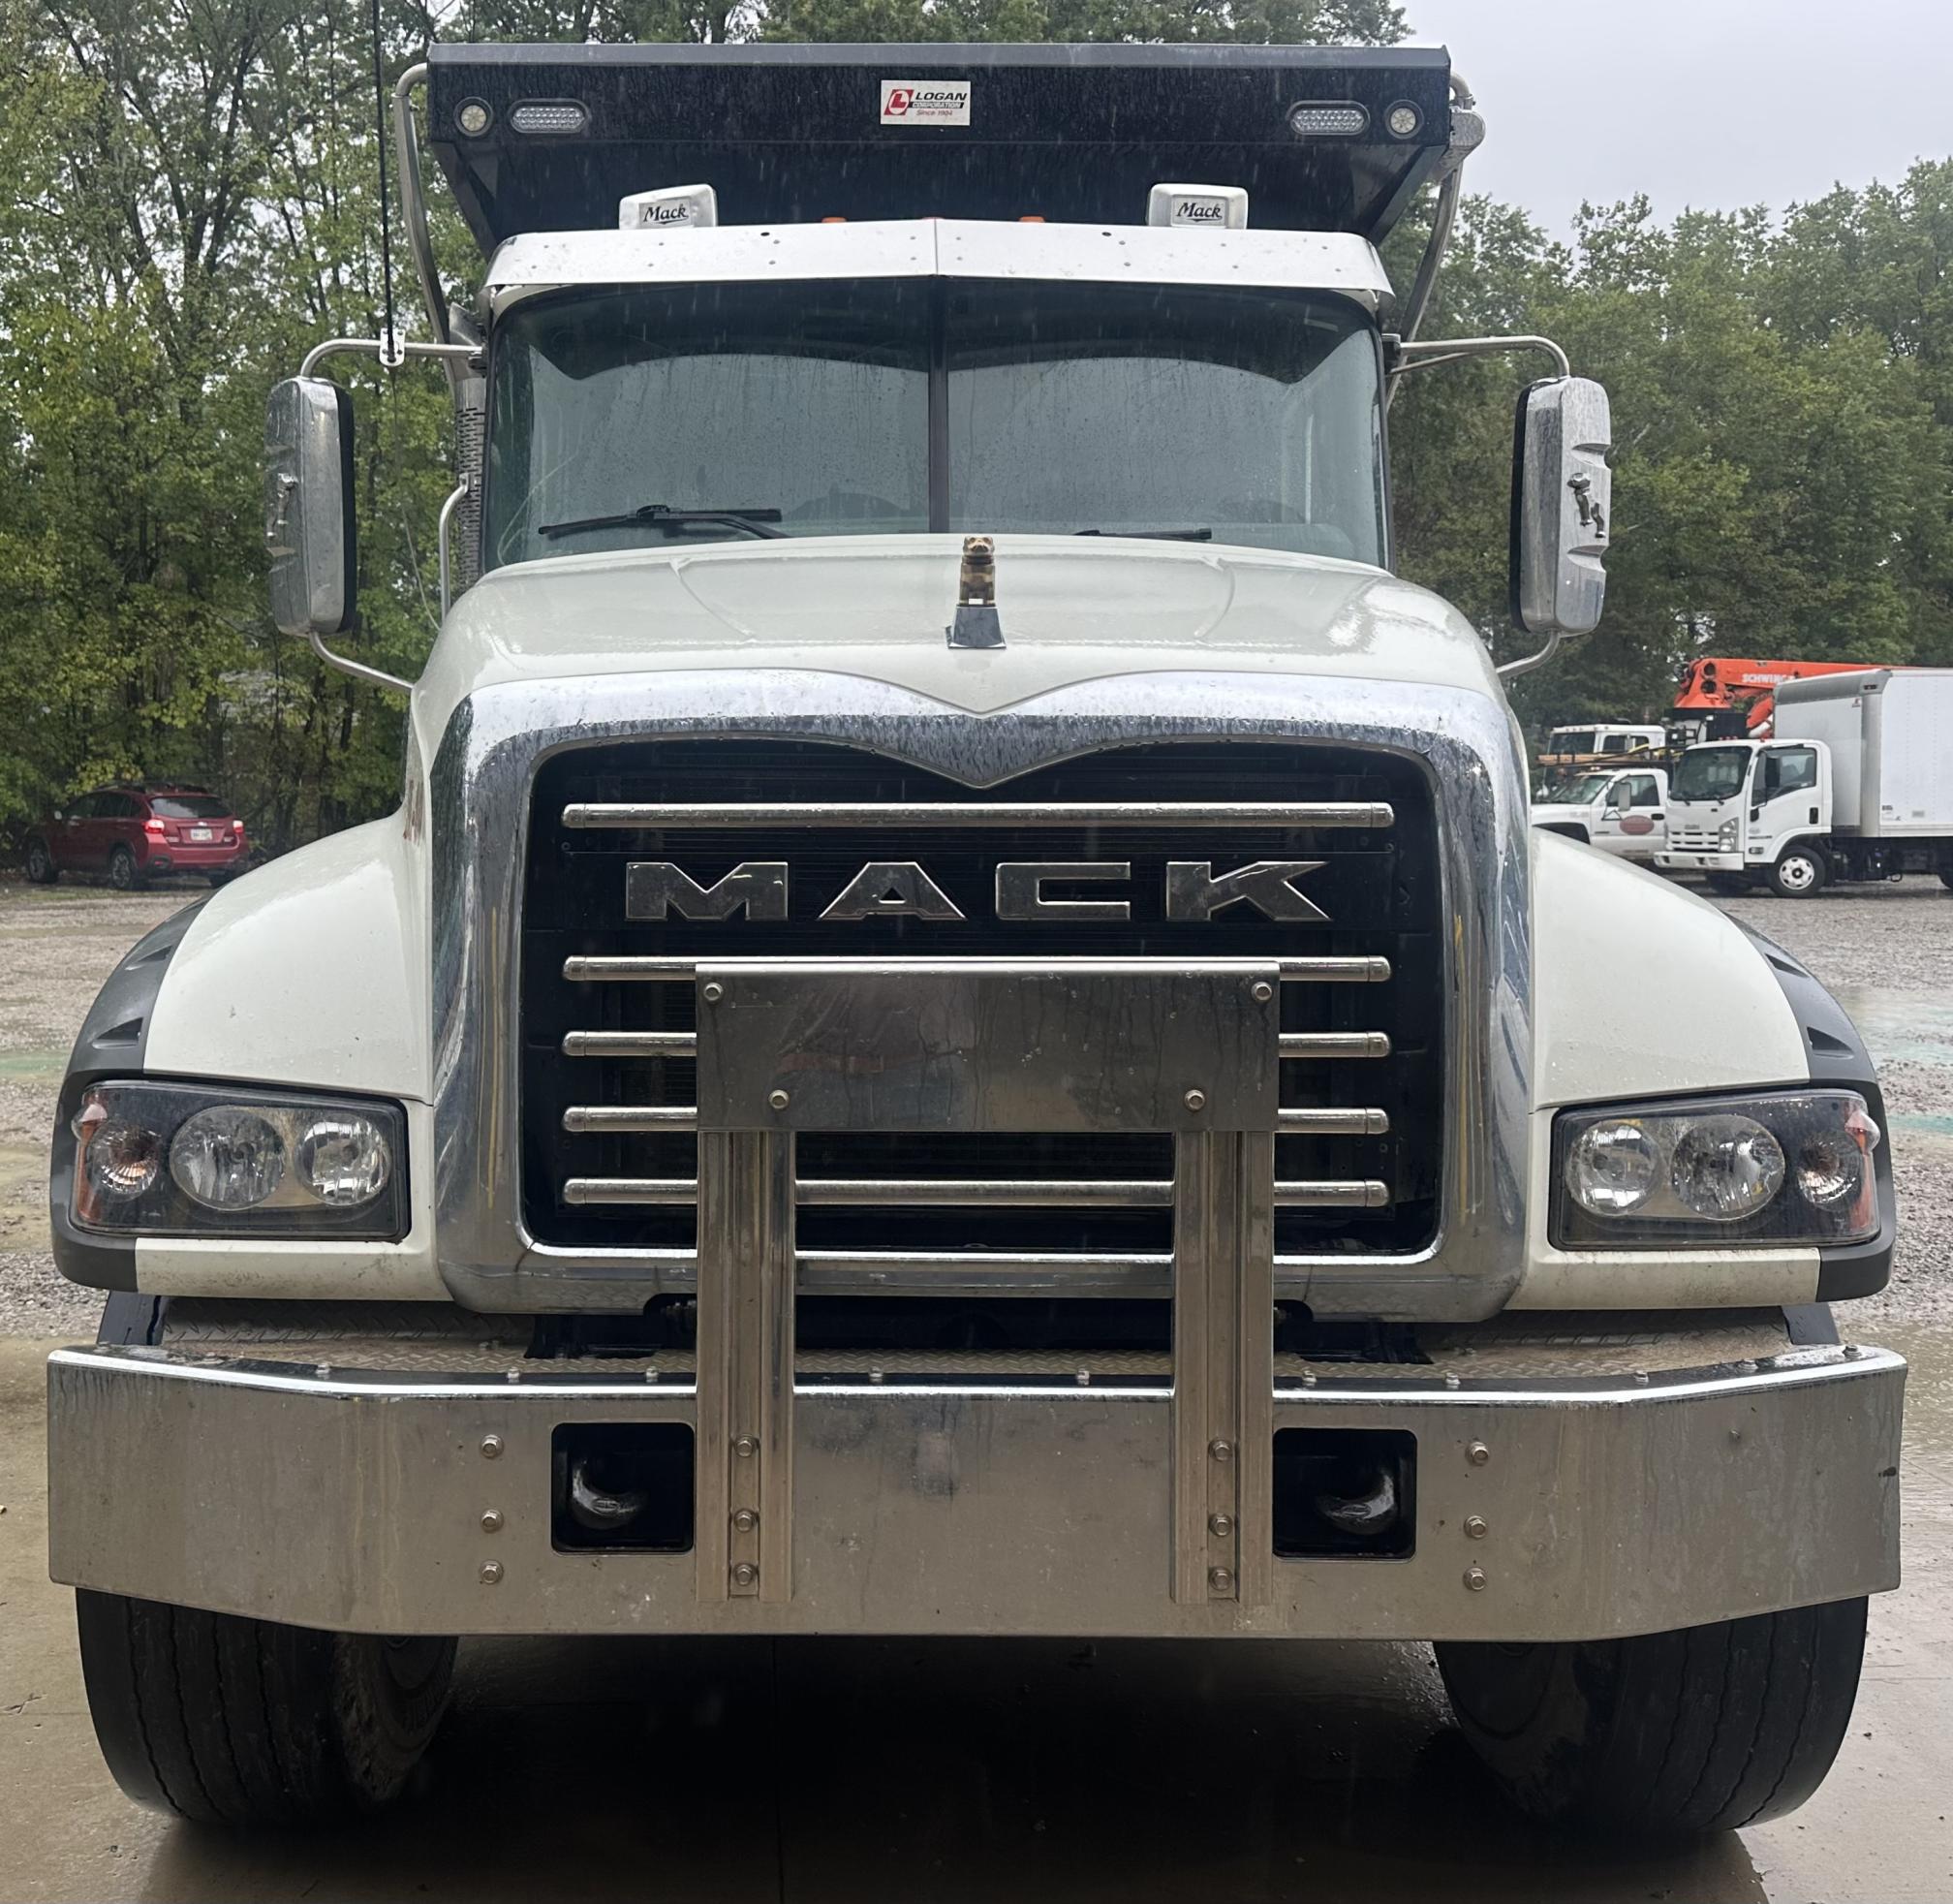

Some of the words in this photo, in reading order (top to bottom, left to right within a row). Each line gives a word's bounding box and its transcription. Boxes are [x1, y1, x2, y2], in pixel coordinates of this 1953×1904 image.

[915, 92, 968, 101] LOGAN
[643, 203, 689, 223] Mack
[1175, 202, 1223, 220] Mack
[624, 861, 1332, 921] MACK
